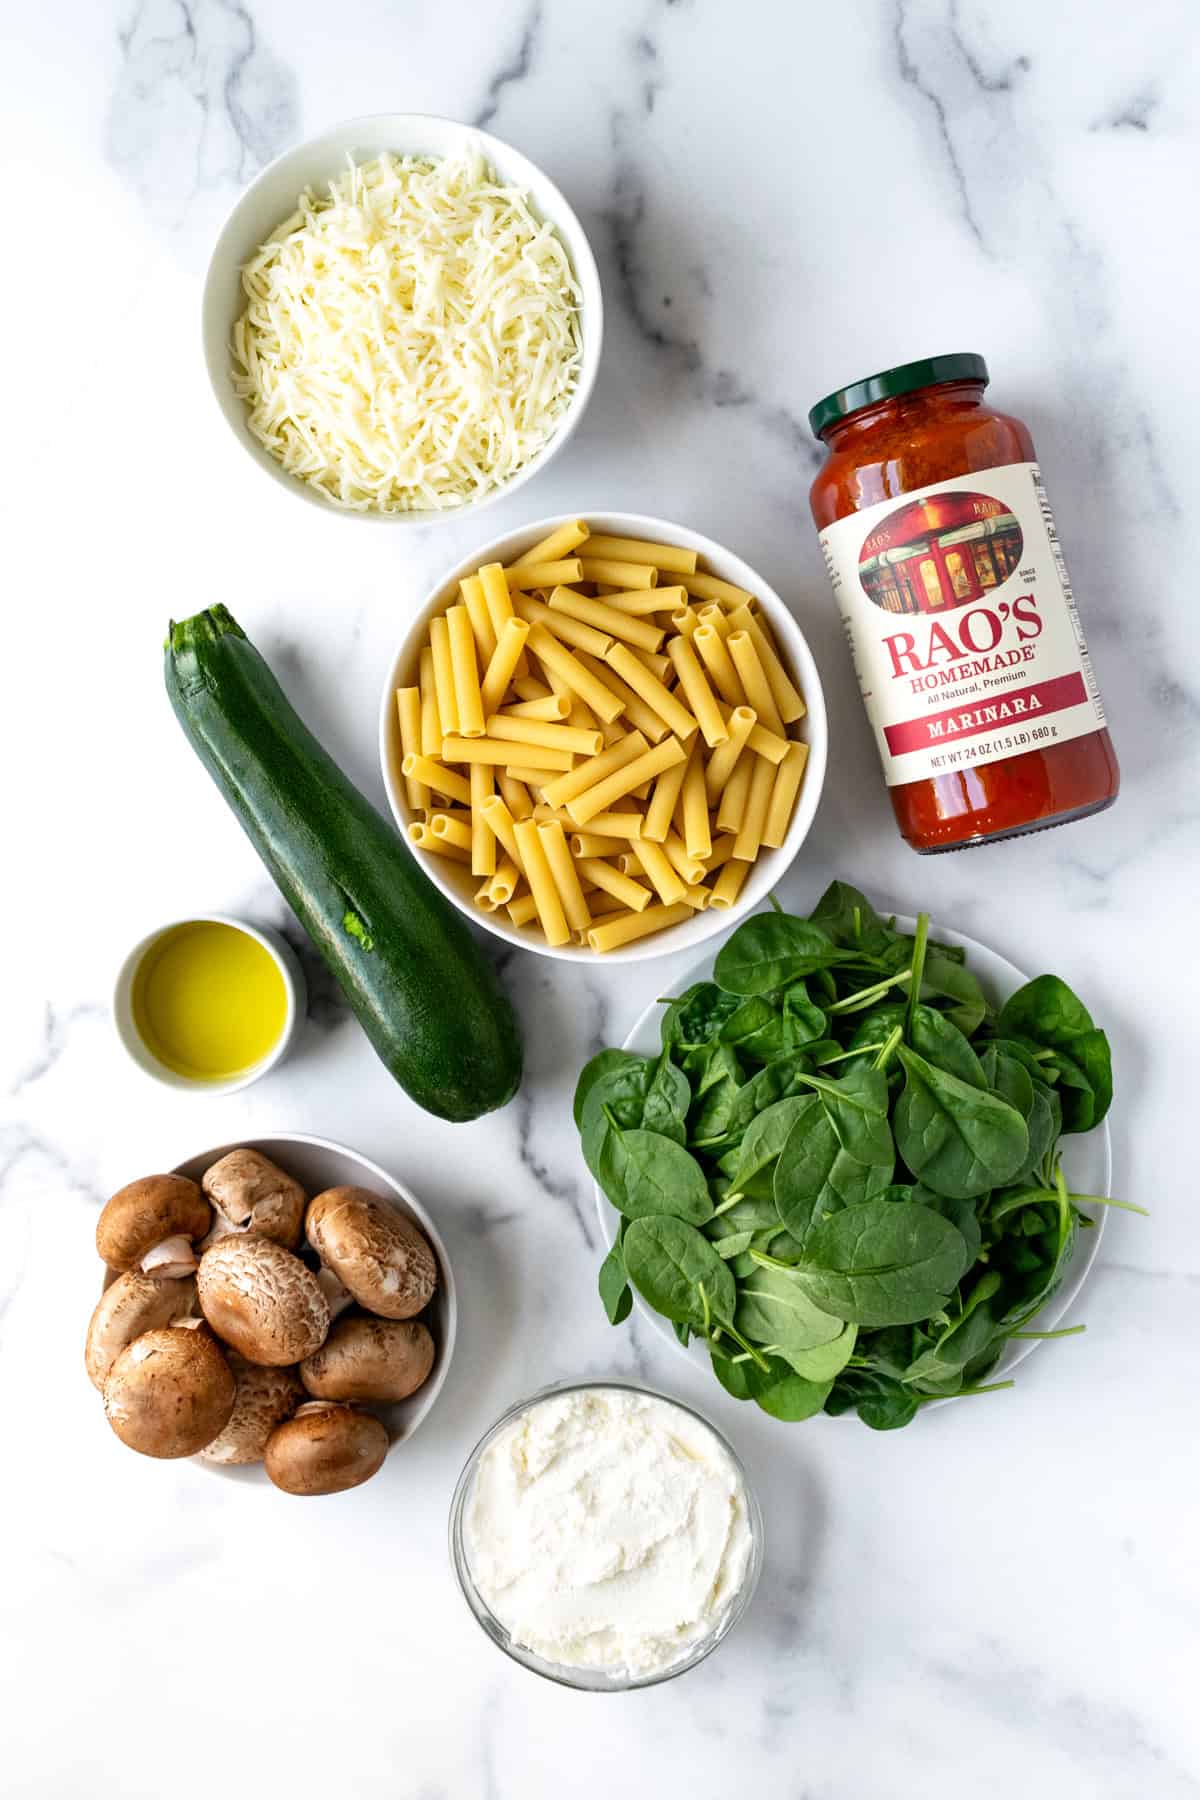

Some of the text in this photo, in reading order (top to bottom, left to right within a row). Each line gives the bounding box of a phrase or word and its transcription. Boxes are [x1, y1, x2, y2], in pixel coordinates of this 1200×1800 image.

[881, 593, 1043, 679] RAO'S
[927, 670, 1026, 704] All Natural, Premium
[926, 694, 1042, 739] MARINARA
[931, 726, 1058, 768] NET WT 24 OZ (1.5 LB) 680 g
